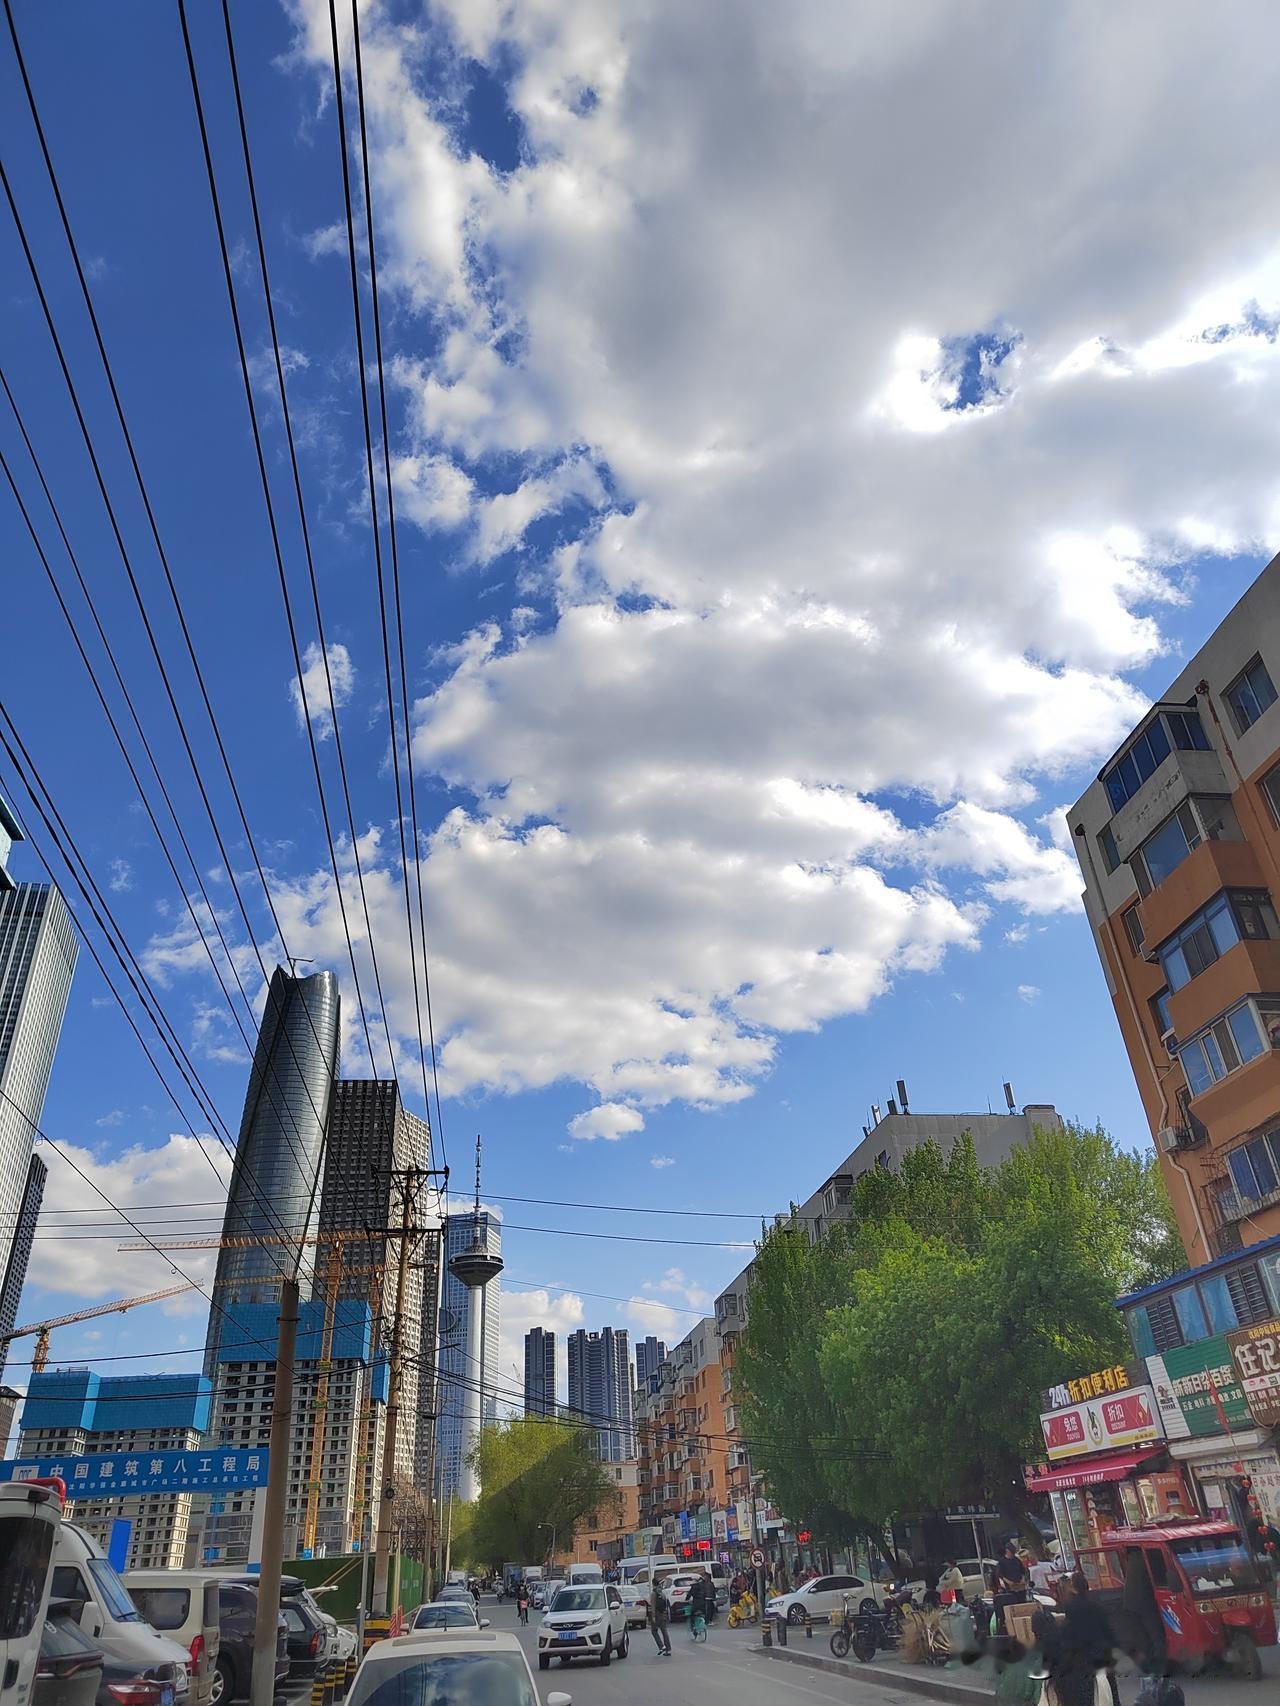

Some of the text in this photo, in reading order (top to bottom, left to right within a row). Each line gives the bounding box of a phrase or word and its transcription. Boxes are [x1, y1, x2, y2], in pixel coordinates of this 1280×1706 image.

[1235, 1337, 1280, 1378] 任记
[1107, 1403, 1125, 1422] 折扣
[49, 1455, 260, 1479] 中国建筑第八工程局
